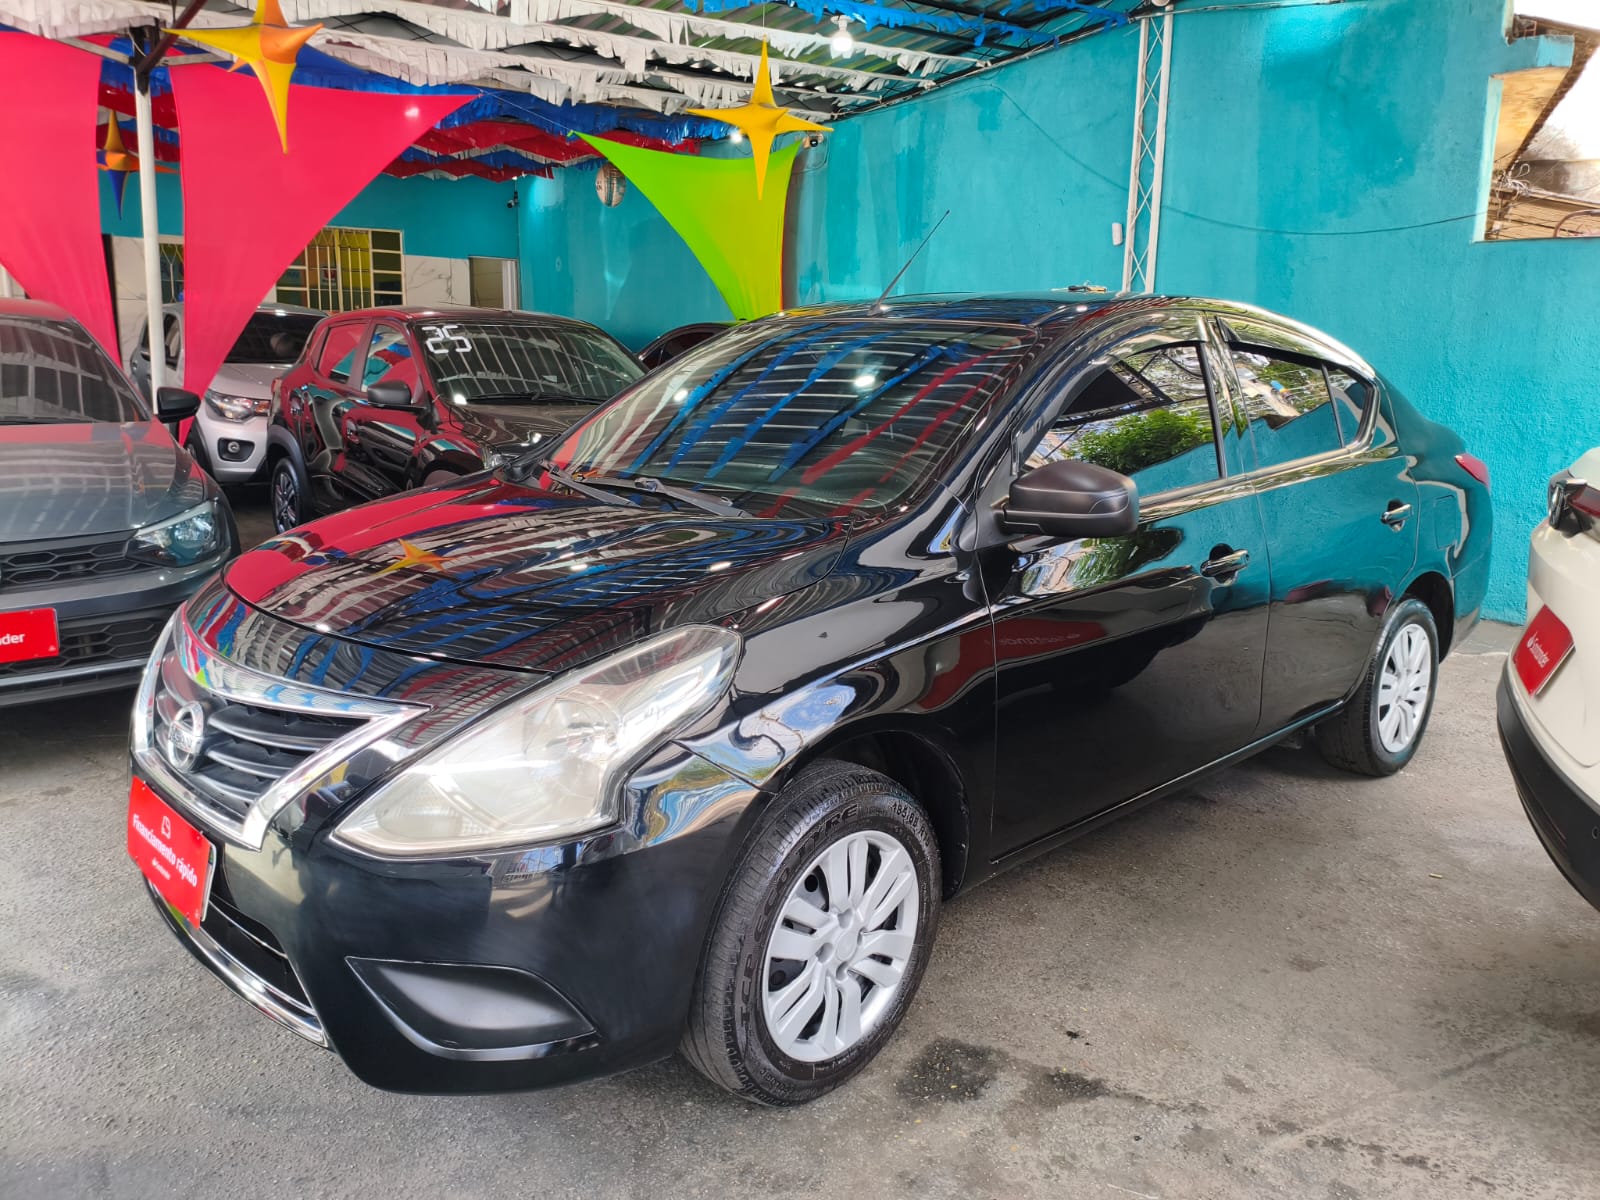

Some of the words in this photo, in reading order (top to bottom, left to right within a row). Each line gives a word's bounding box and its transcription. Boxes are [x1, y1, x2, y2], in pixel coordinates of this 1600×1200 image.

[422, 325, 472, 354] 25
[133, 814, 176, 865] Financiamento
[176, 858, 198, 887] rápido
